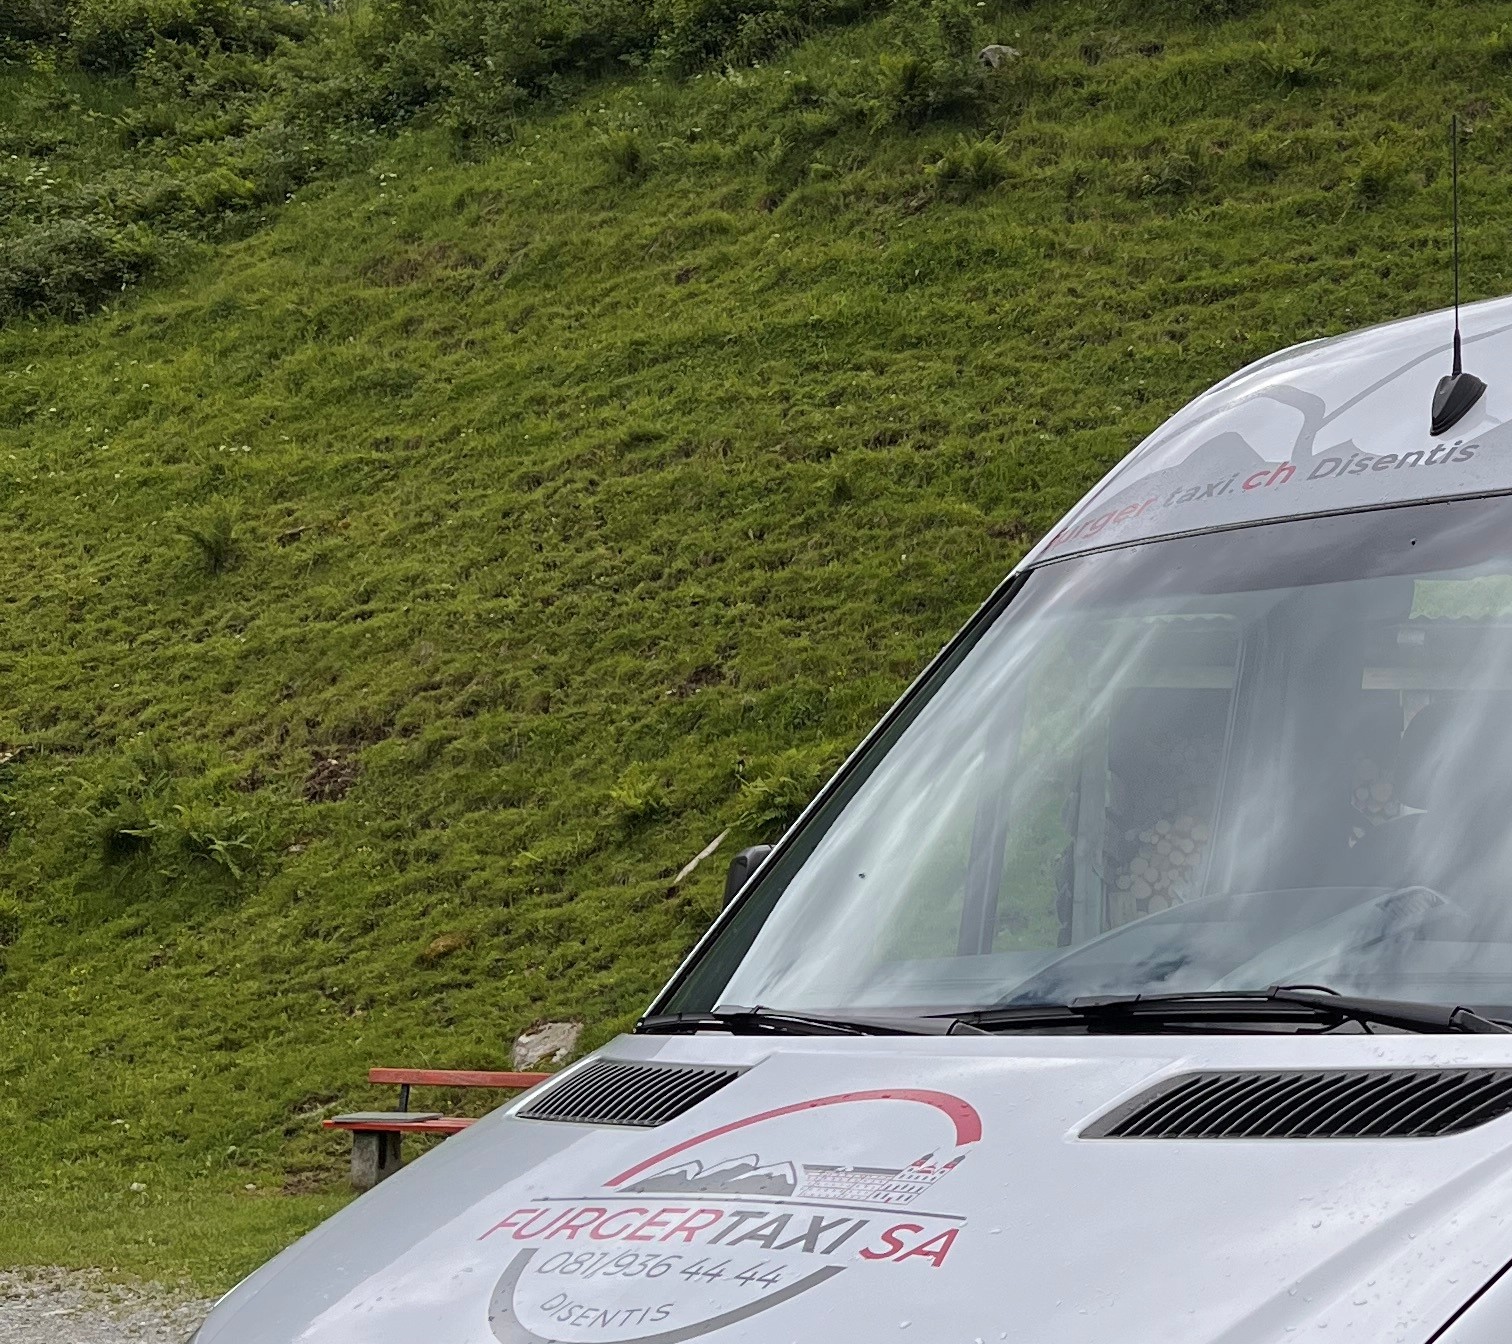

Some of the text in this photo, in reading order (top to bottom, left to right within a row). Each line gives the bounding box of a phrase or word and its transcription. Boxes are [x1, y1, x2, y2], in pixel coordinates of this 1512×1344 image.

[1306, 439, 1480, 481] Disentis
[478, 1207, 961, 1269] FURGERTAXI SA
[680, 1257, 734, 1284] 44
[733, 1259, 789, 1290] 44
[539, 1291, 676, 1328] DISENTIS
